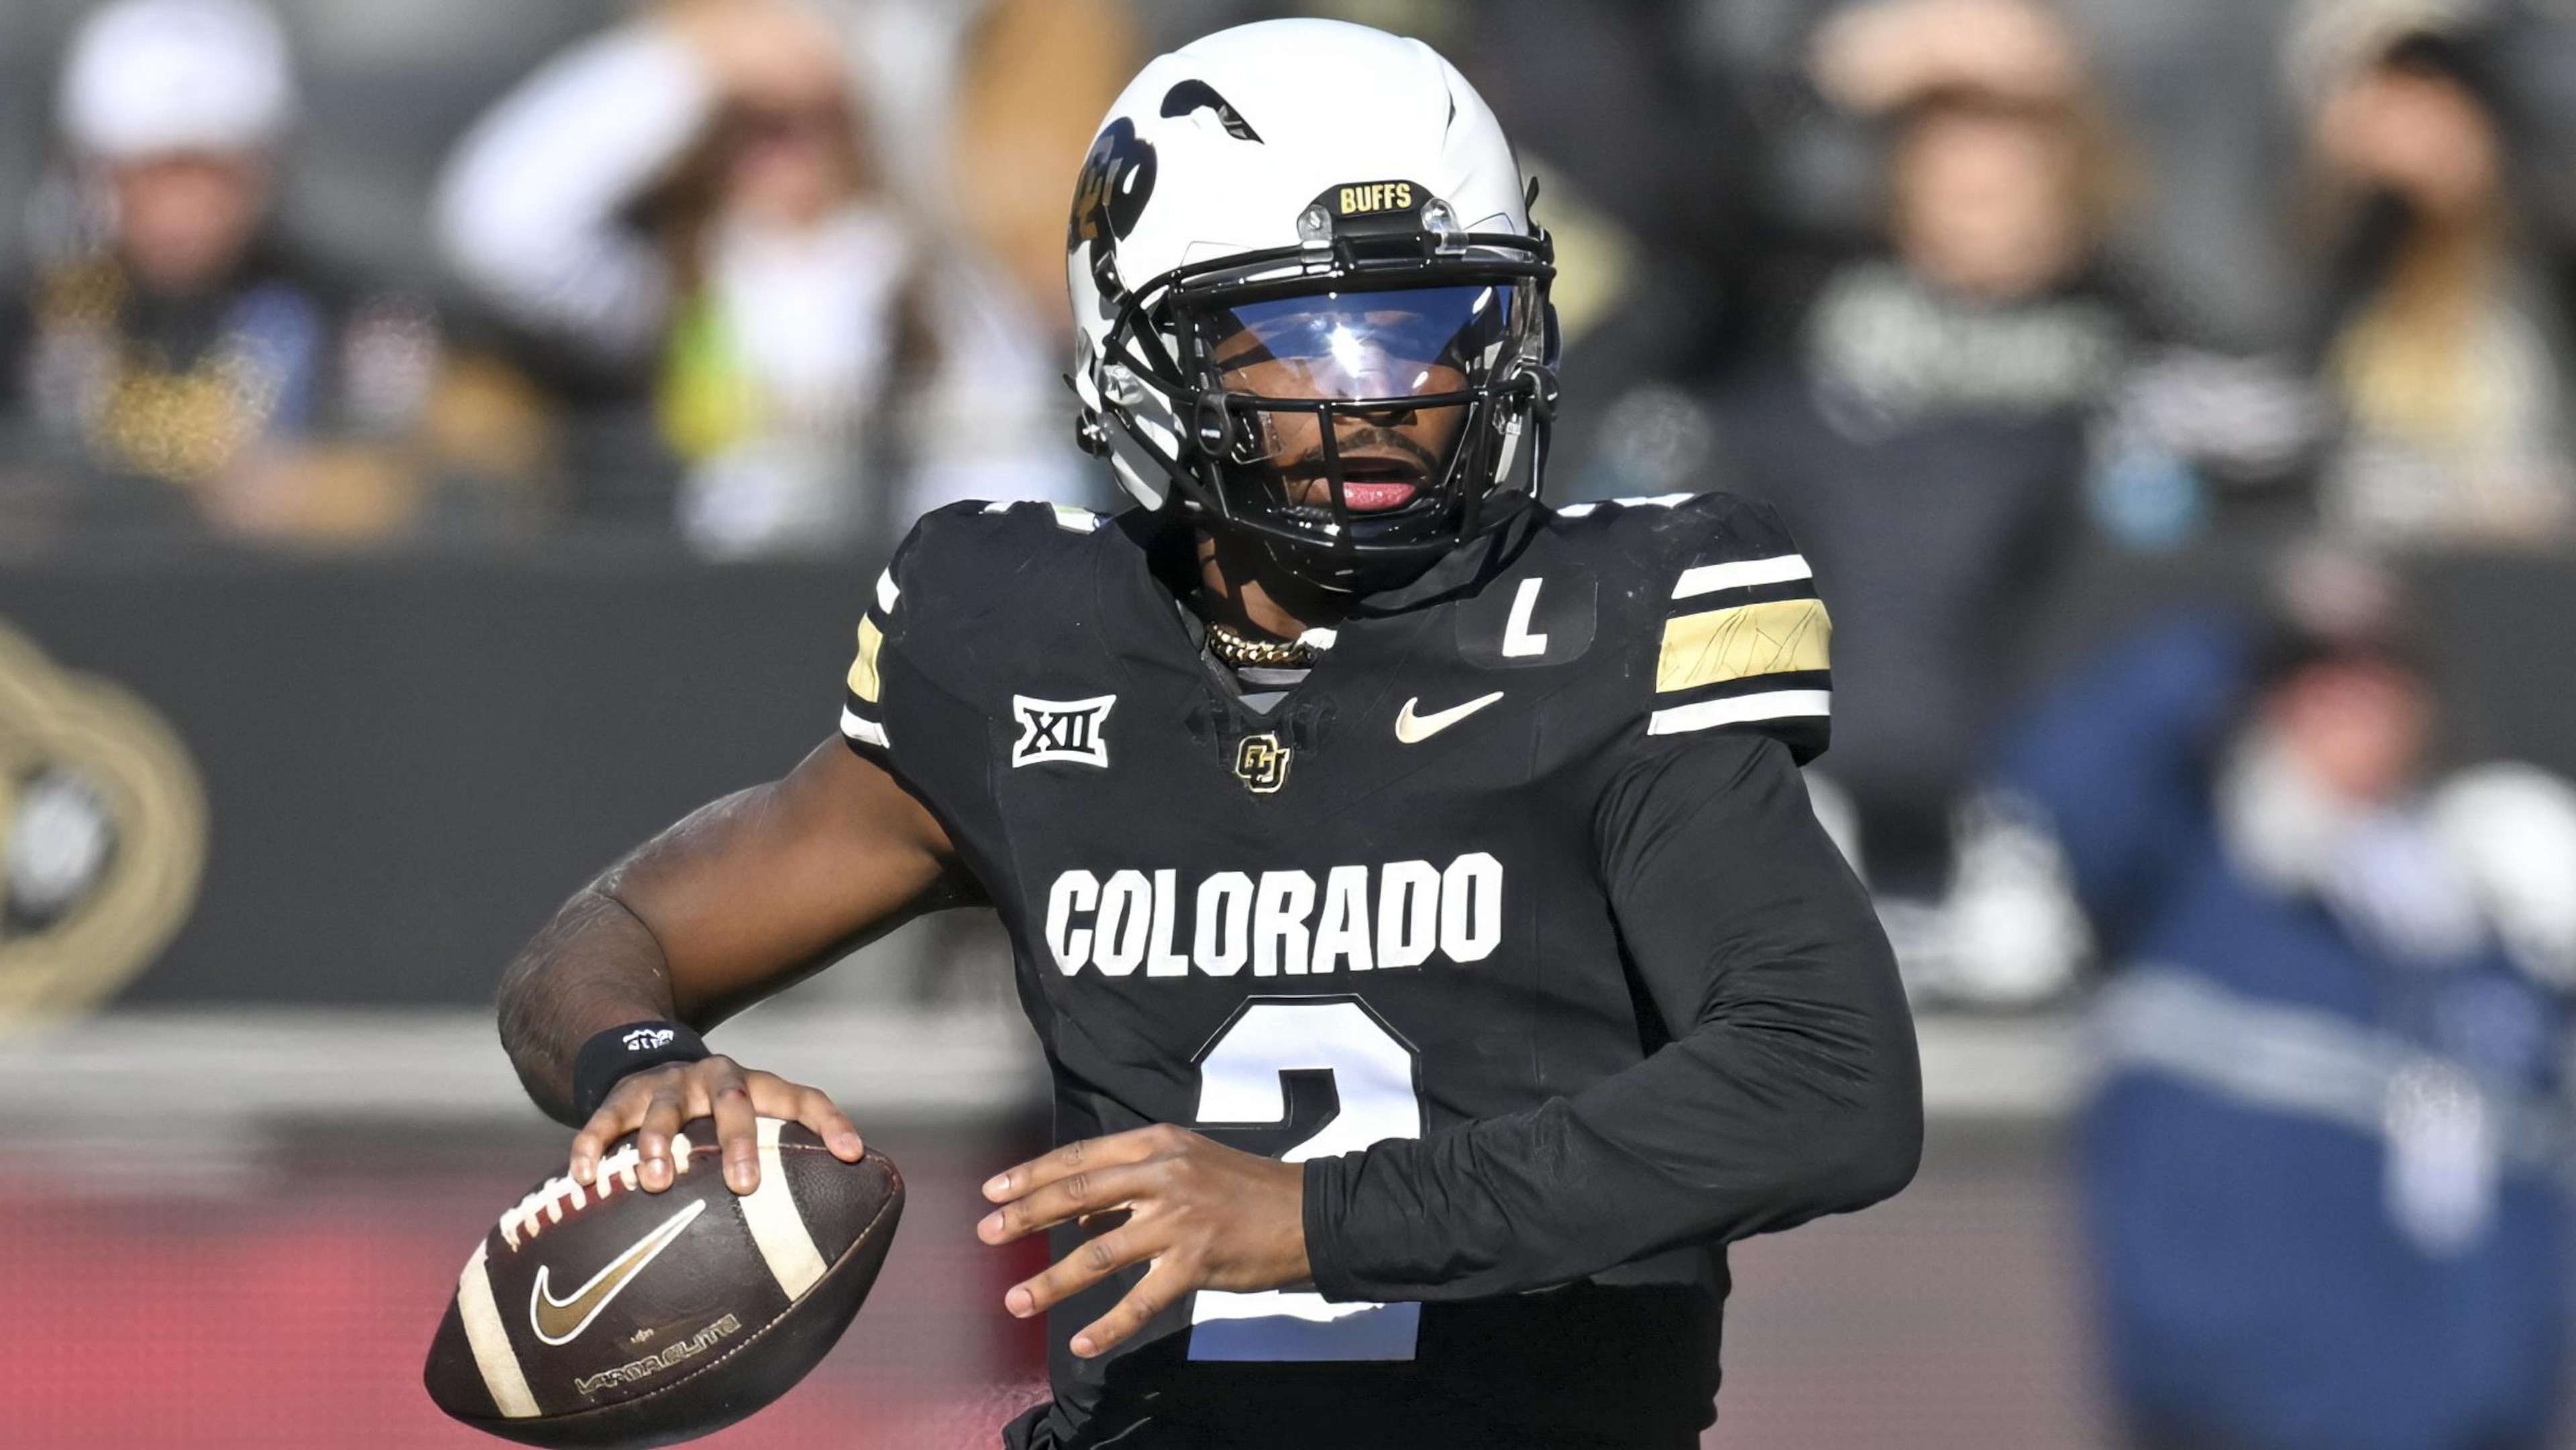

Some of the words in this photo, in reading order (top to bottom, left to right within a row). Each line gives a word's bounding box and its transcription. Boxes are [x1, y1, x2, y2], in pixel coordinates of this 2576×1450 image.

[1340, 183, 1411, 214] BUFFS
[1501, 577, 1548, 657] L
[1018, 705, 1103, 759] XII
[1235, 732, 1291, 793] CU
[1045, 852, 1503, 977] COLORADO
[1187, 1001, 1422, 1361] 2
